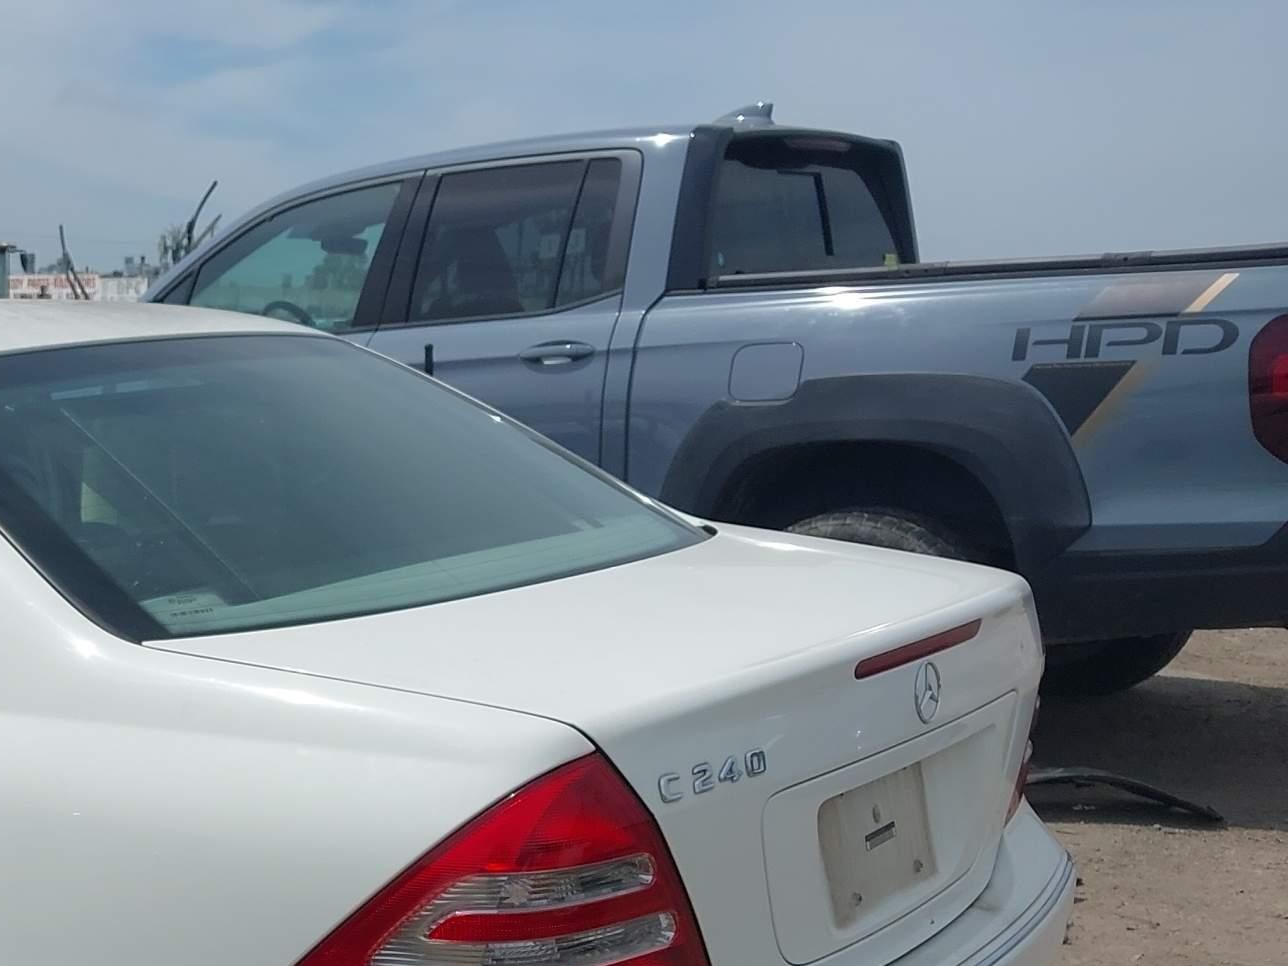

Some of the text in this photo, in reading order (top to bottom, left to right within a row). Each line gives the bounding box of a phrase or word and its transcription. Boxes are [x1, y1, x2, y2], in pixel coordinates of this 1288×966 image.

[1012, 318, 1240, 361] HPD
[658, 748, 766, 804] C 240
